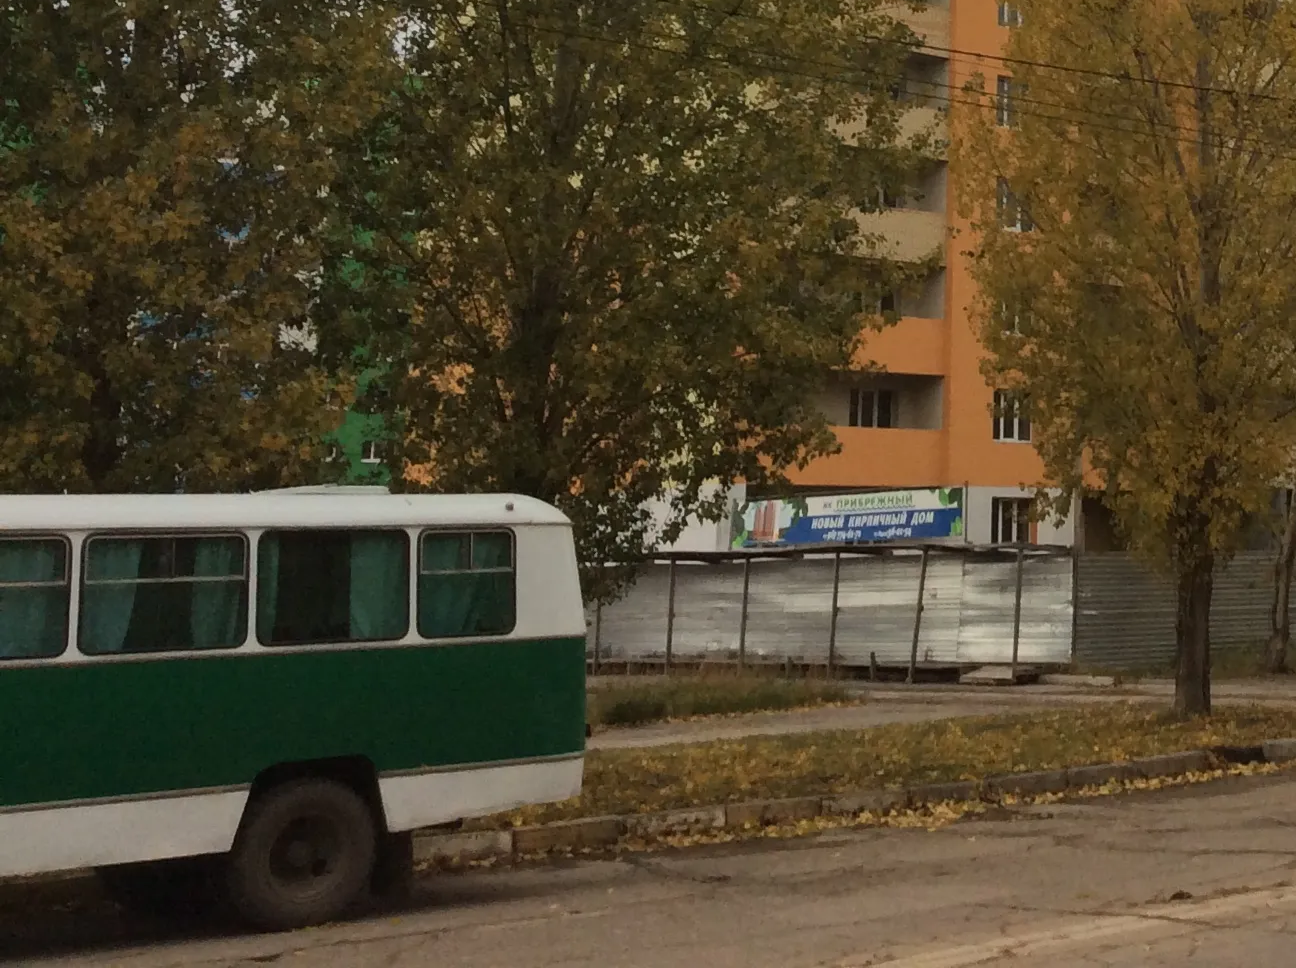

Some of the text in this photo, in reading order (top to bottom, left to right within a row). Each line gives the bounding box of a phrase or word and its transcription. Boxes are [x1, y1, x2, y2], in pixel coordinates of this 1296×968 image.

[836, 494, 913, 509] ПРИБРЕЖНЫЙ
[811, 511, 935, 530] НОВЫЙ КИРПИЧНЫЙ ДОМ
